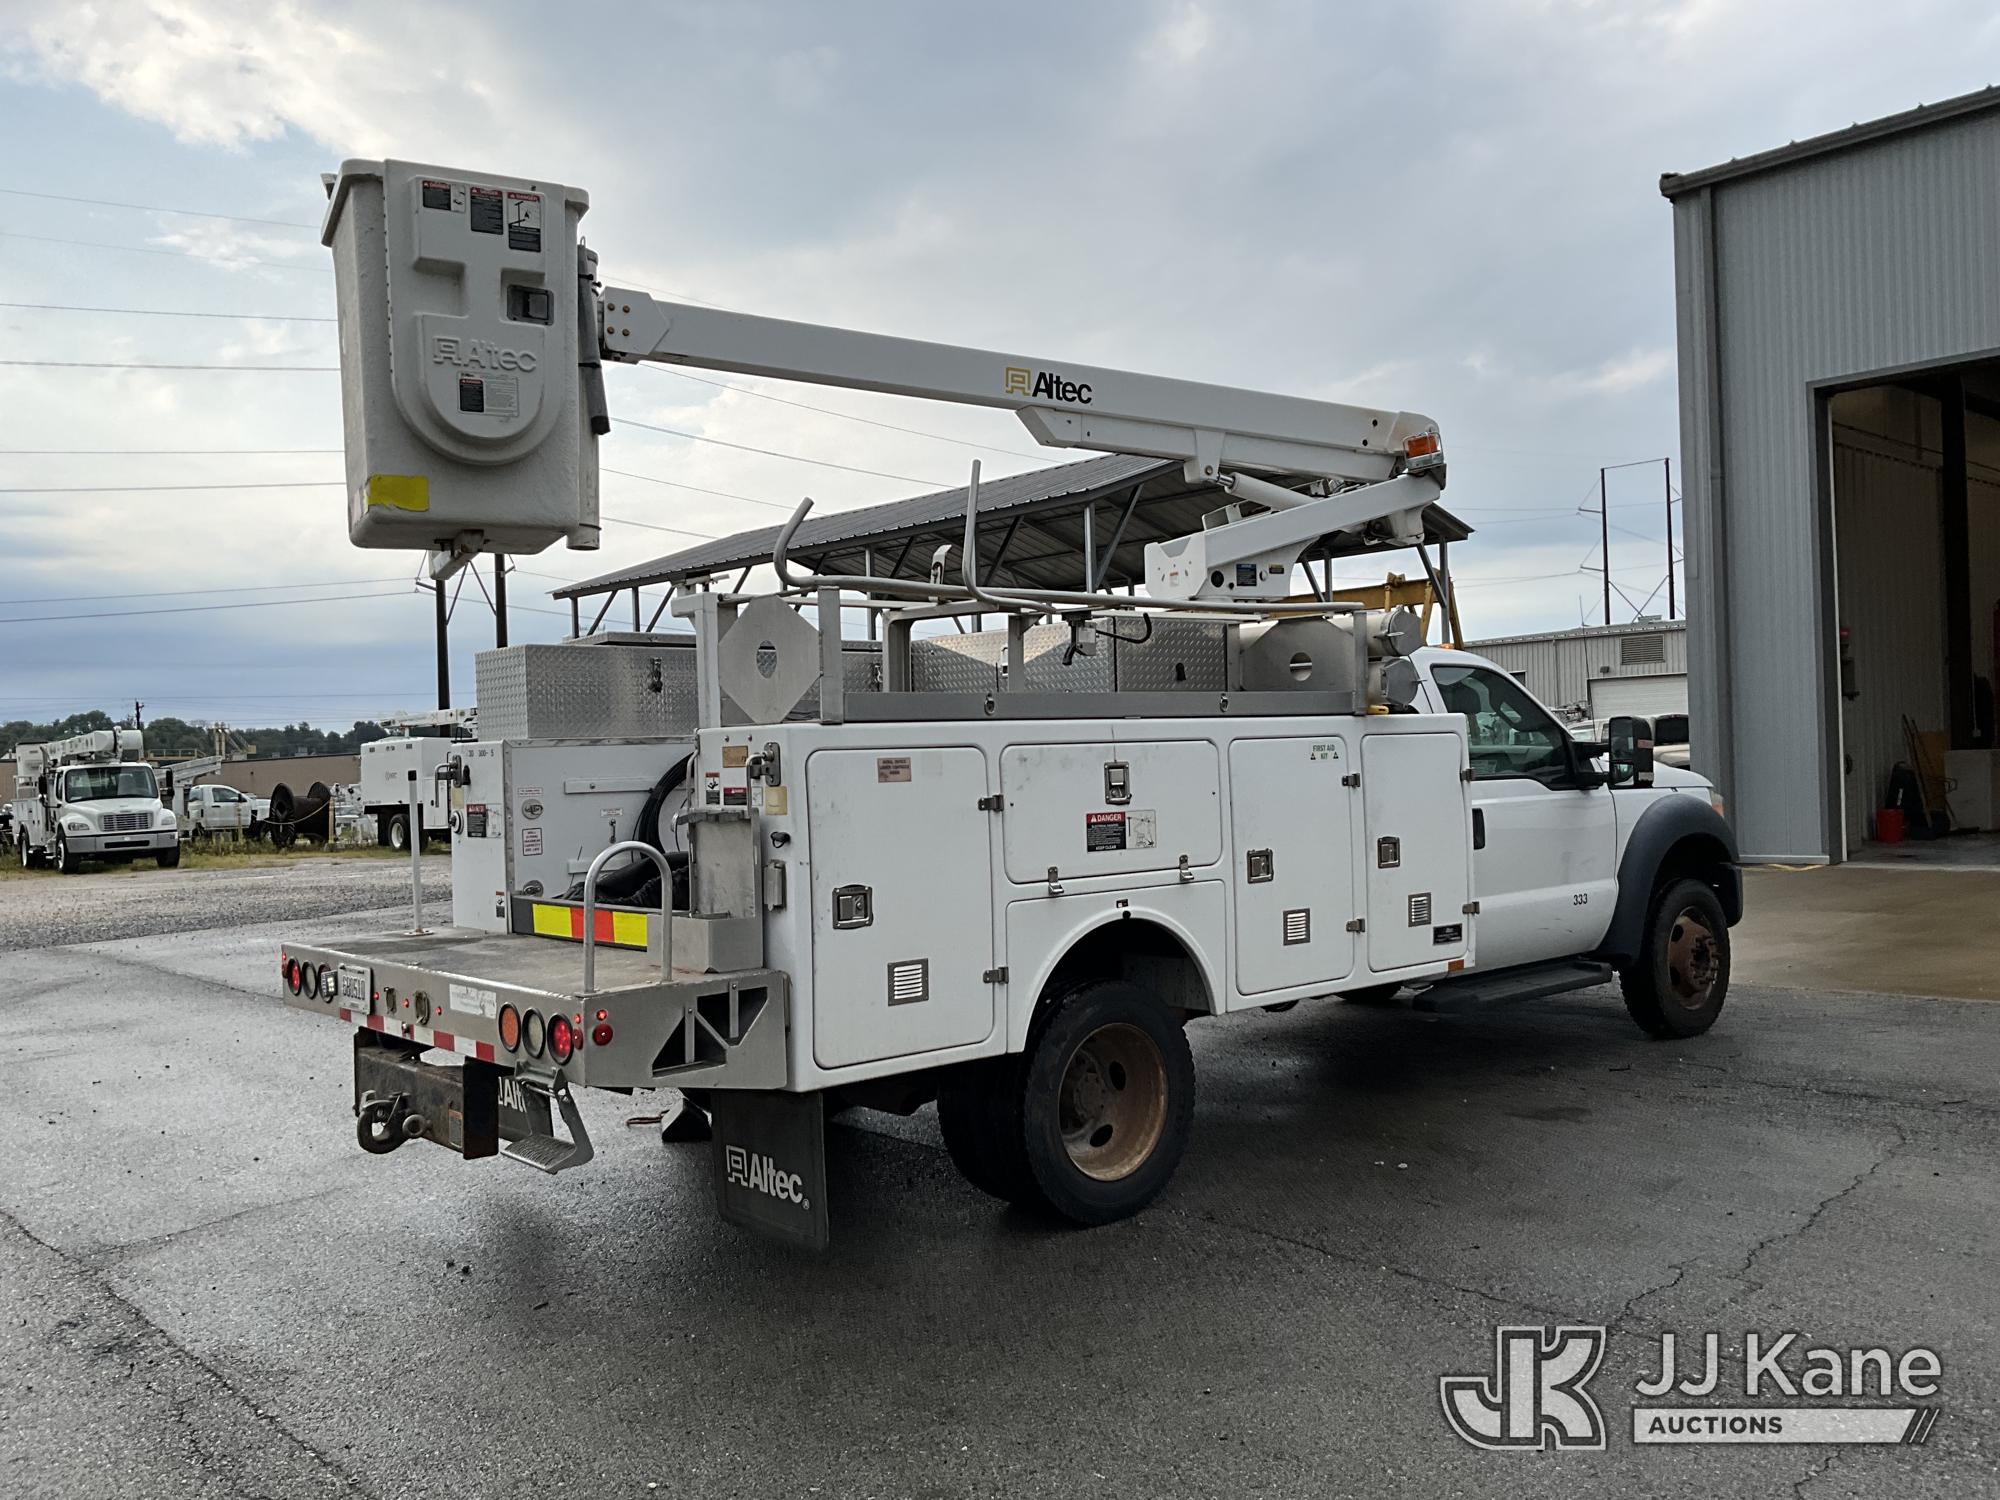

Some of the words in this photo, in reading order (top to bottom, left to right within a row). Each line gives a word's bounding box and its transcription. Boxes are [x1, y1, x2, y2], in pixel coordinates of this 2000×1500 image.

[463, 338, 537, 373] Altec
[1032, 371, 1093, 405] Altec
[1312, 744, 1326, 752] FIRST
[1327, 743, 1336, 752] AID
[1320, 752, 1328, 760] KIT
[1097, 813, 1122, 822] DANGER
[1573, 893, 1588, 905] 333
[748, 1152, 804, 1204] Altec
